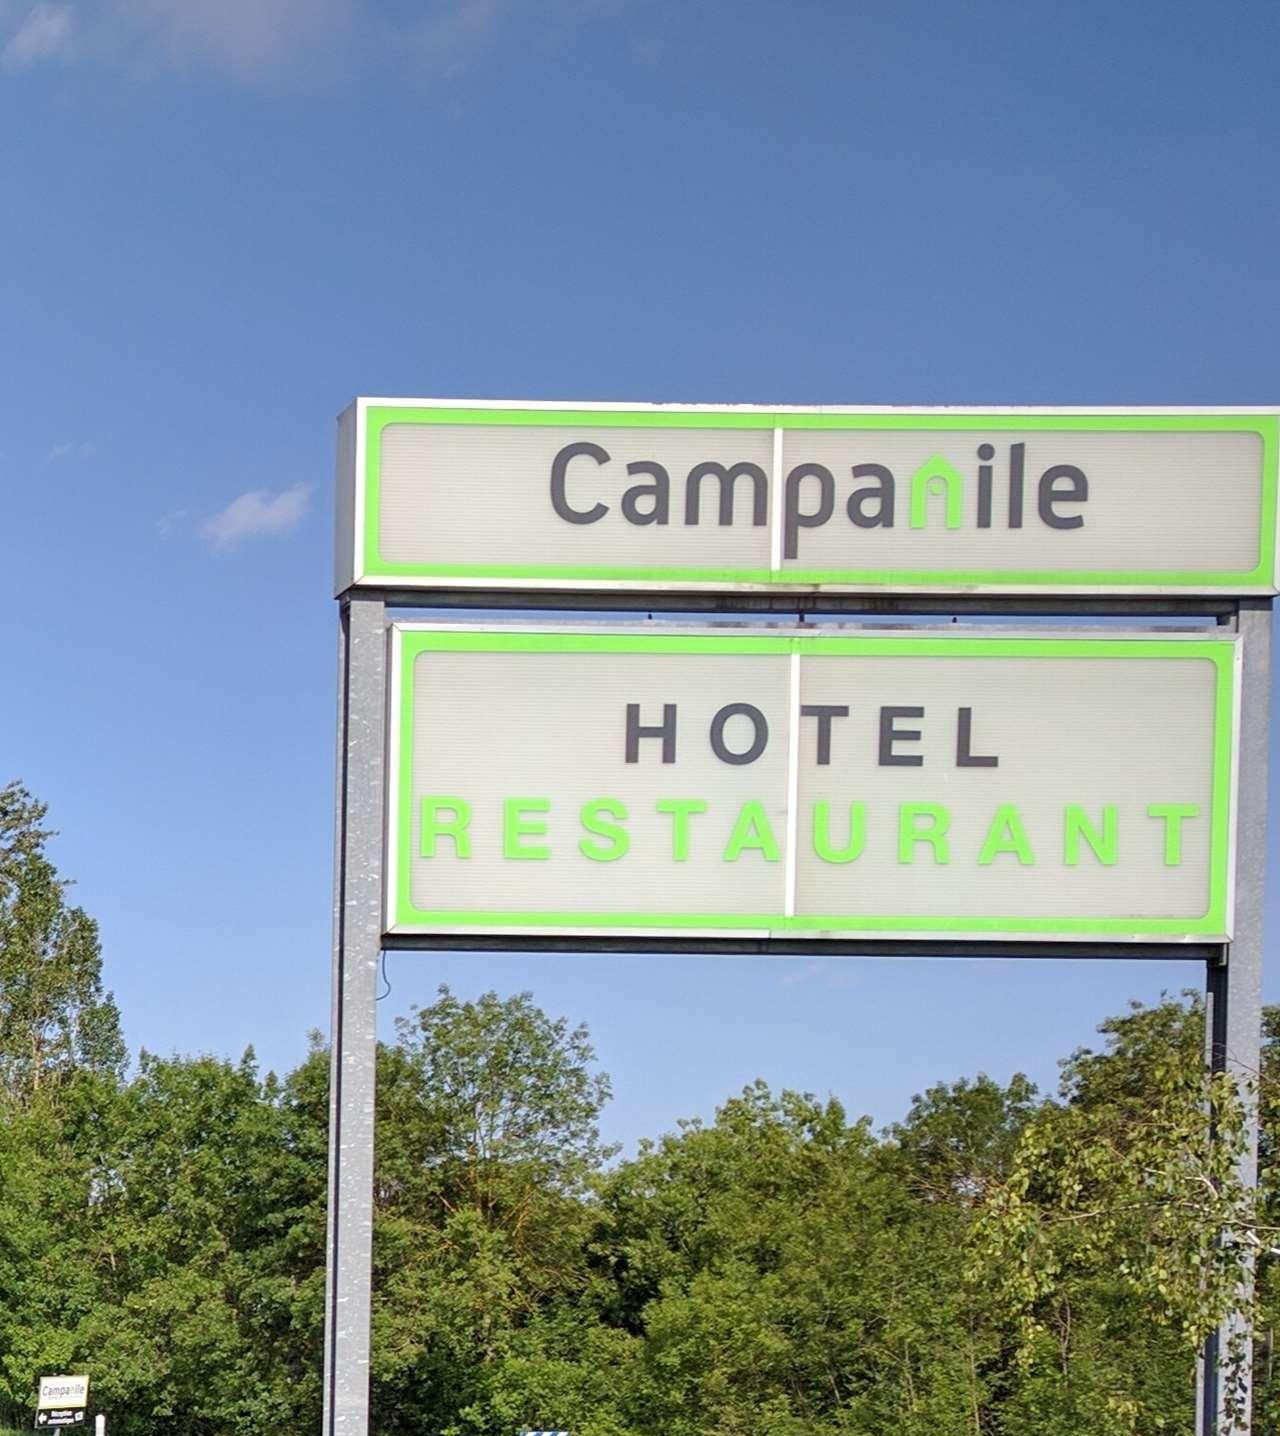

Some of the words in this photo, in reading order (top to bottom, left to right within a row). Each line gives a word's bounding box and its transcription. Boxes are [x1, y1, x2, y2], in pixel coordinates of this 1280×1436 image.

[550, 442, 1089, 560] Campanile
[625, 702, 999, 768] HOTEL
[419, 795, 1201, 867] RESTAURANT
